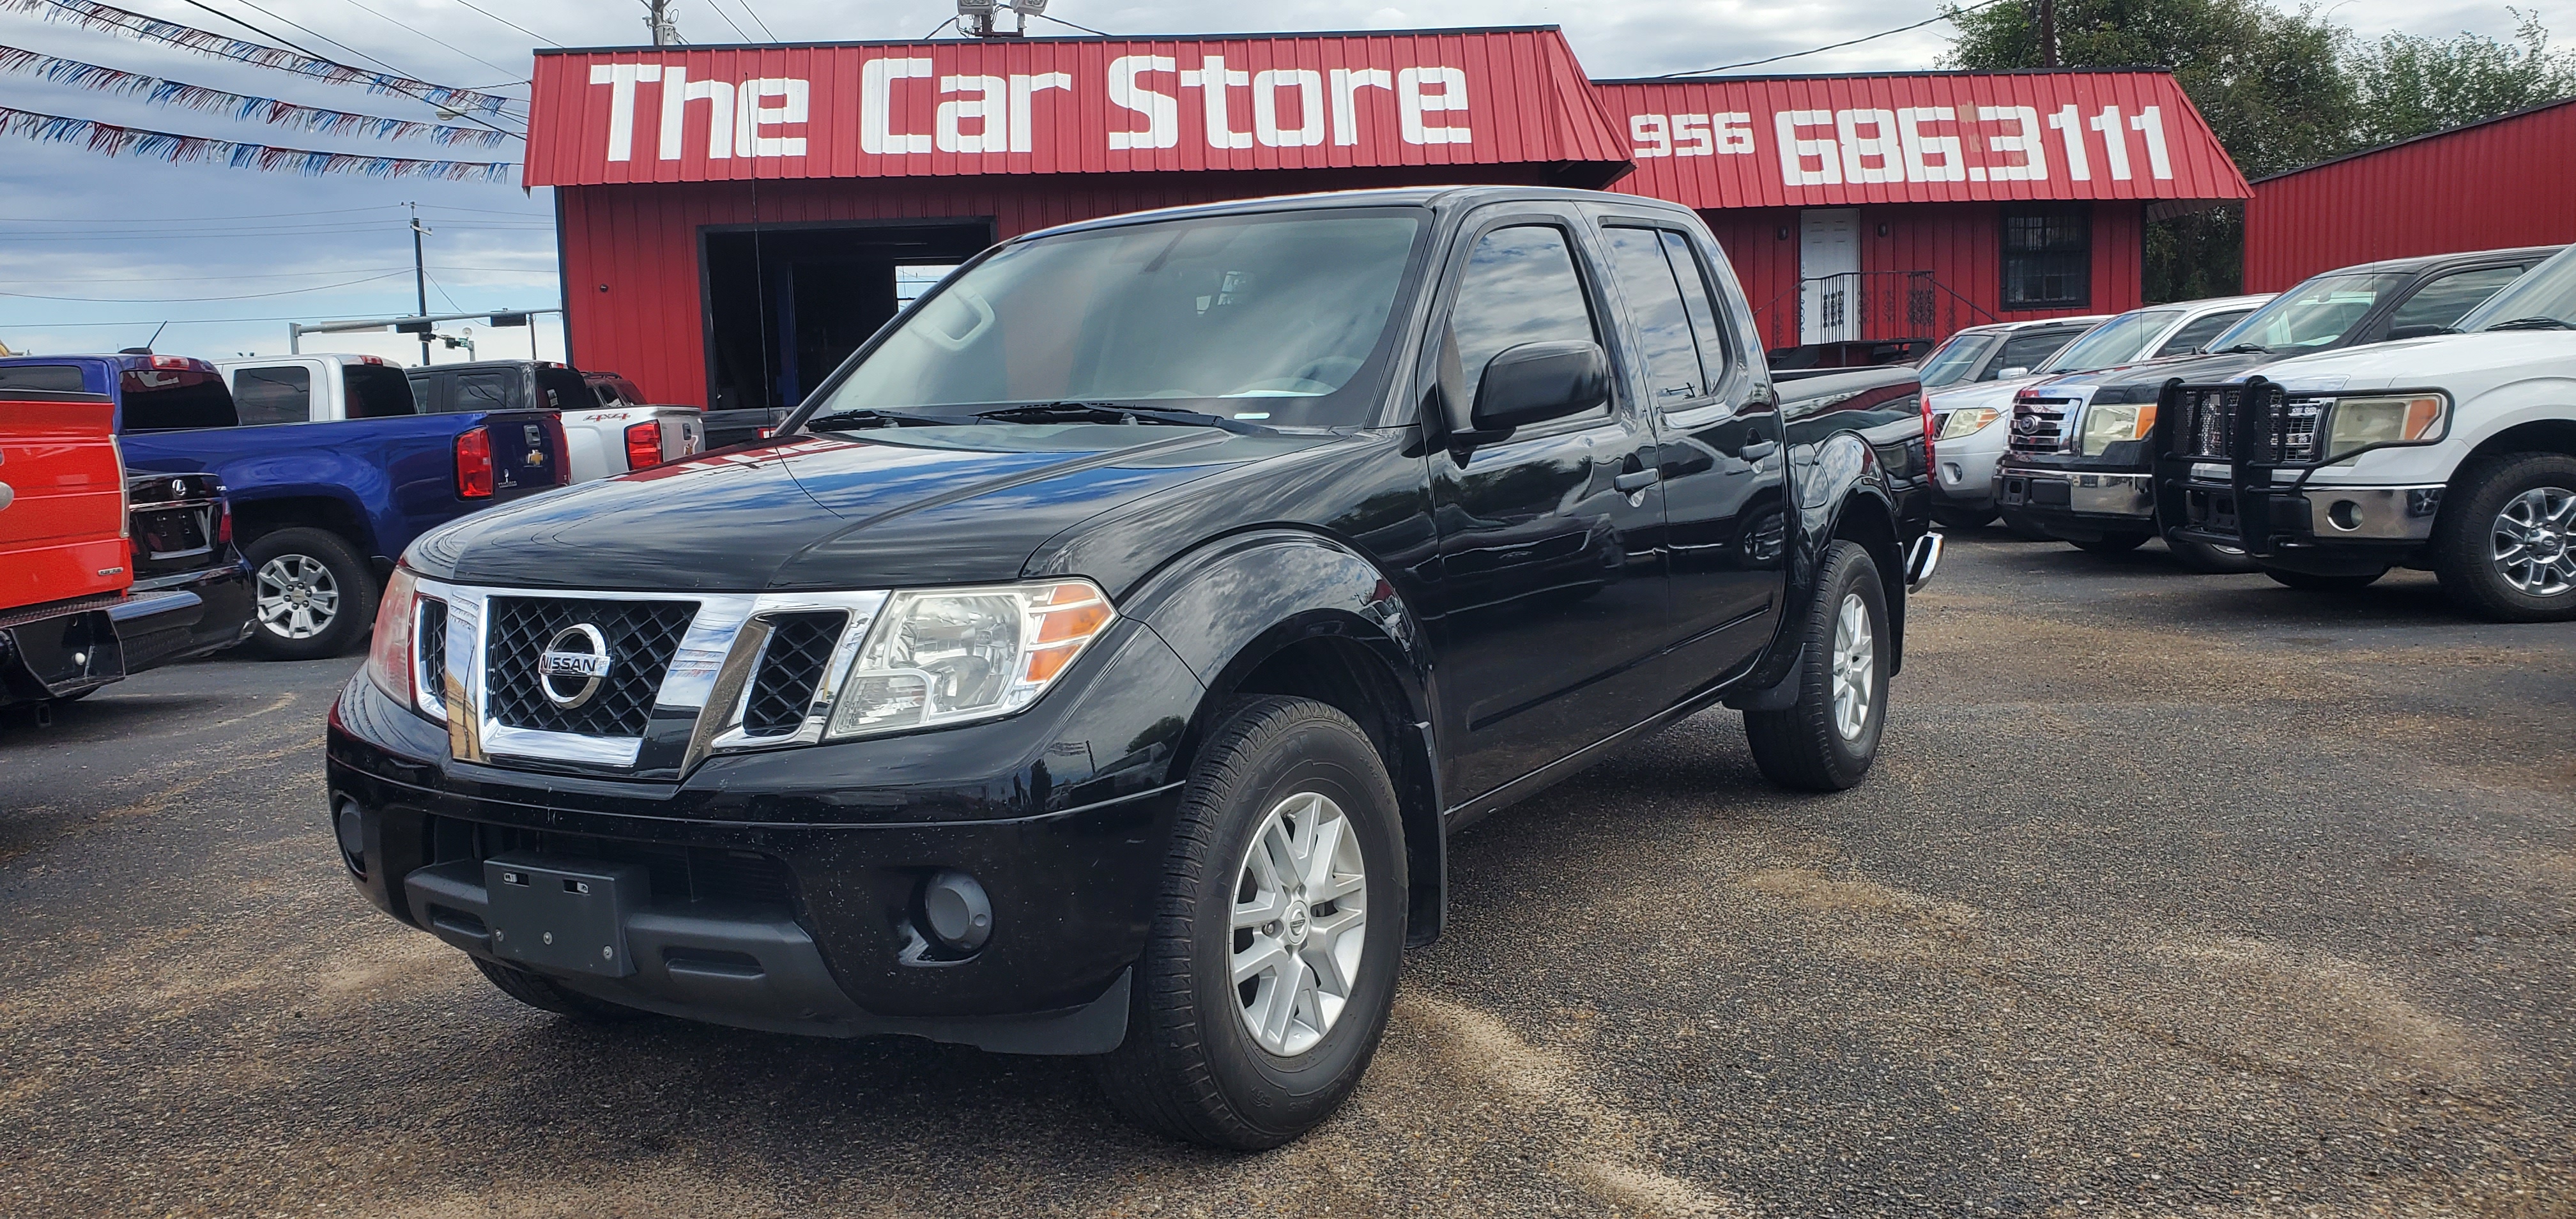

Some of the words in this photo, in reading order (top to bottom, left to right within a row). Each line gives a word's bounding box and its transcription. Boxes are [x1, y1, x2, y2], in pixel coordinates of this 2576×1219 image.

[590, 63, 809, 161] The
[861, 57, 1071, 155] Car
[1108, 55, 1472, 150] Store
[1630, 112, 1755, 158] 956
[540, 654, 597, 673] NISSAN
